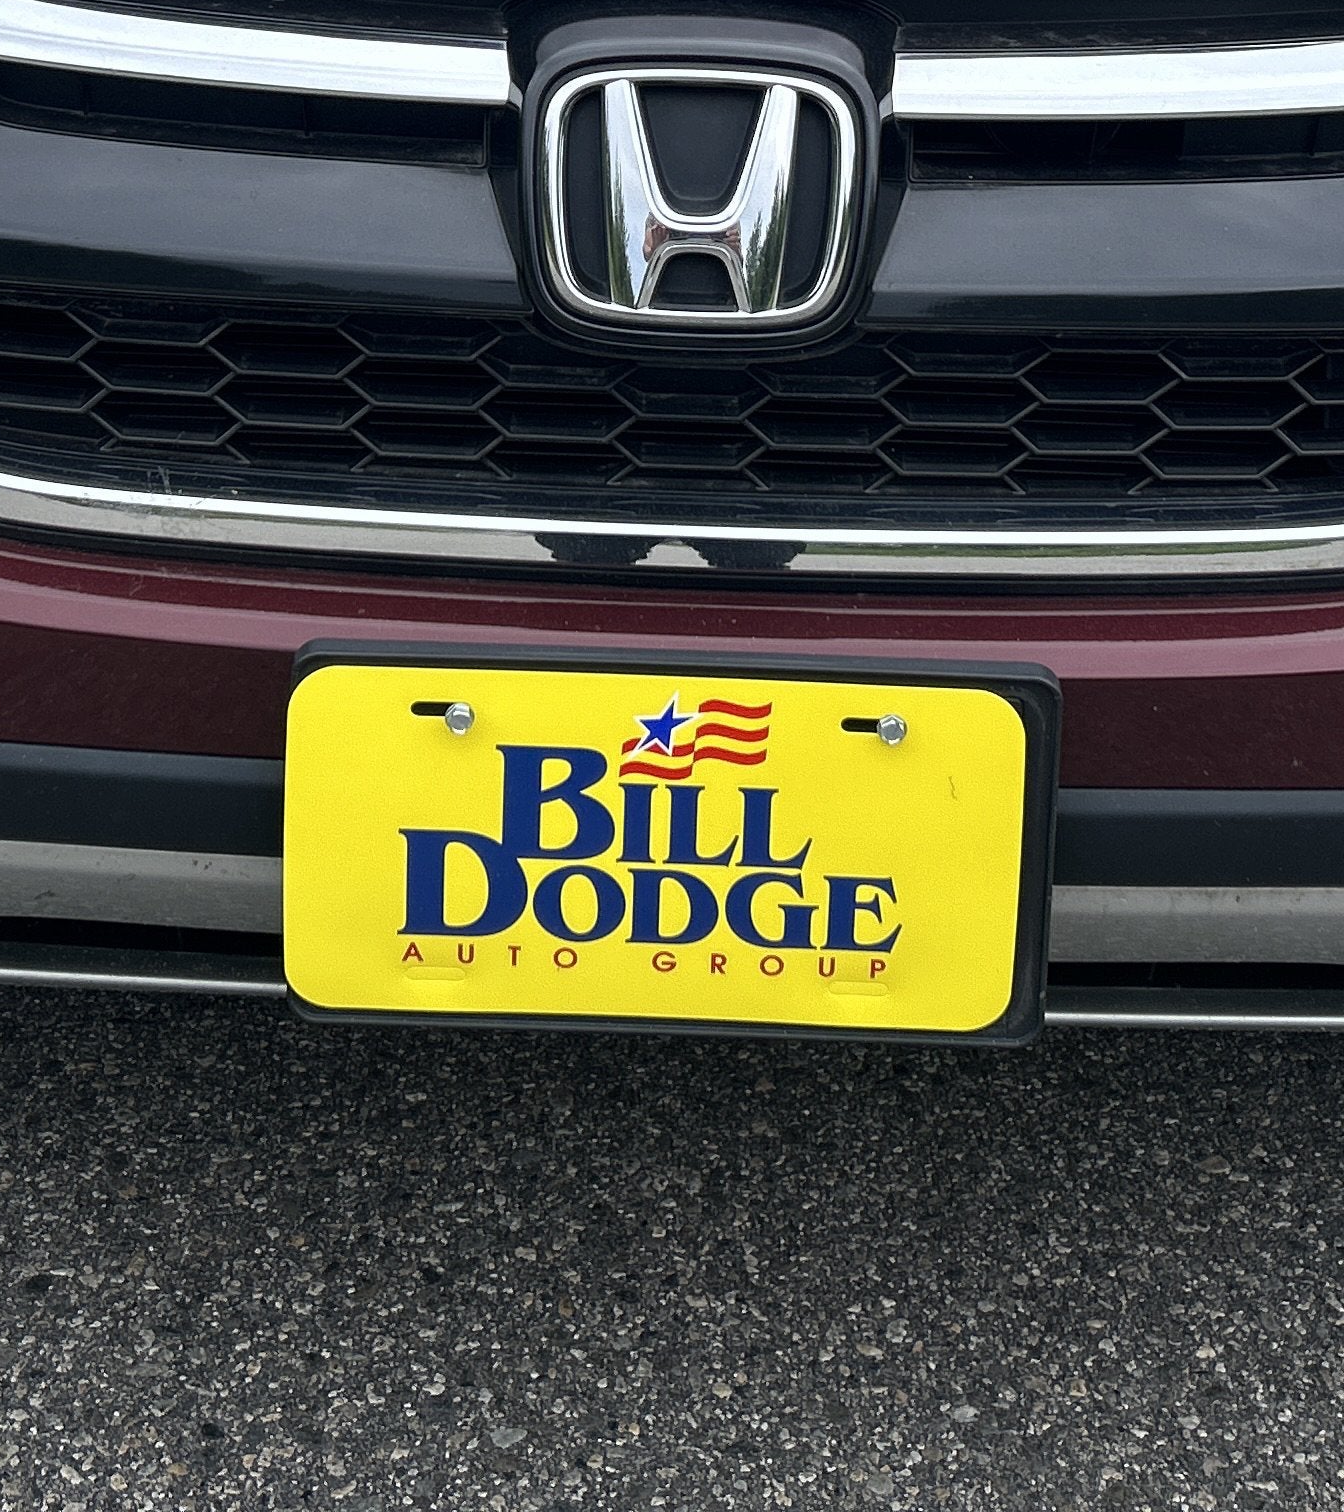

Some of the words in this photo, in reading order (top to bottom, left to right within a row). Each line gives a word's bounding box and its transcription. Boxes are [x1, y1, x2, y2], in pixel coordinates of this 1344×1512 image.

[495, 744, 813, 870] BILL
[397, 827, 903, 953] DODGE
[402, 942, 578, 969] AUTO
[652, 951, 888, 979] GROUP
